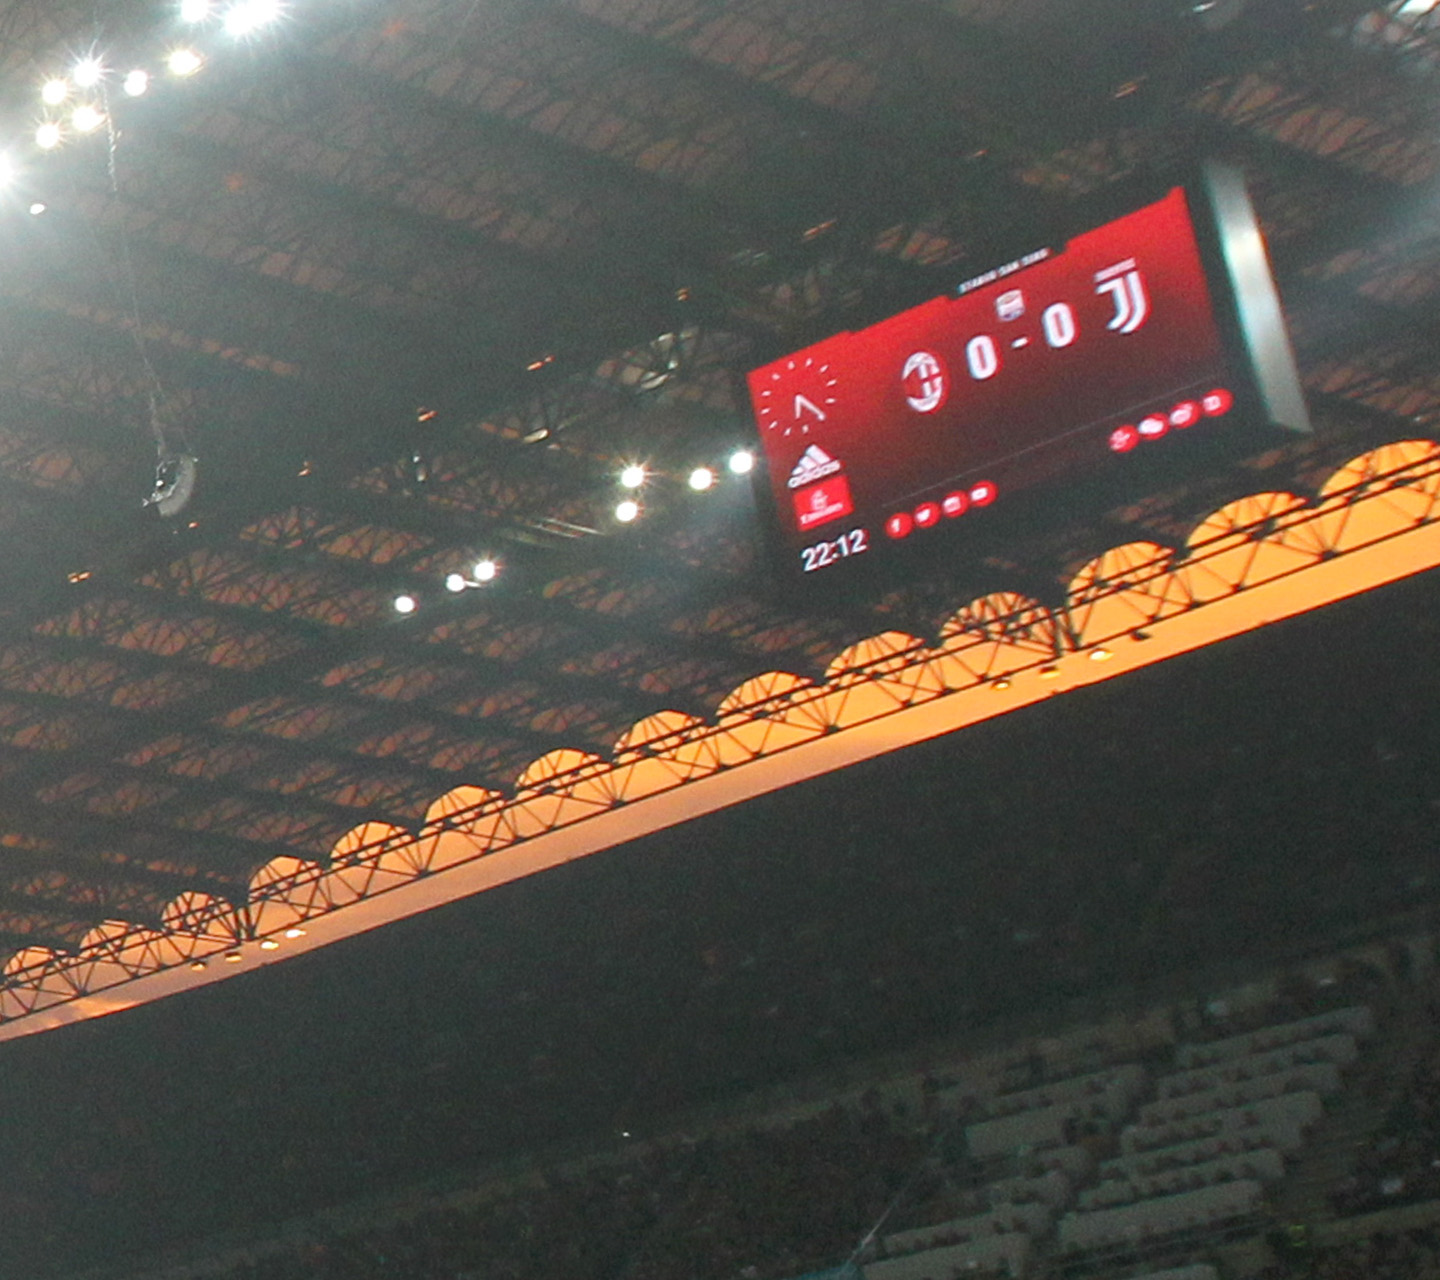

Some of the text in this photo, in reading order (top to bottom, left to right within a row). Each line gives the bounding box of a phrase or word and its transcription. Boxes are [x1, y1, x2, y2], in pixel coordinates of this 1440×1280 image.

[966, 334, 998, 380] 0
[1042, 302, 1075, 348] 0
[801, 528, 867, 571] 22:12
